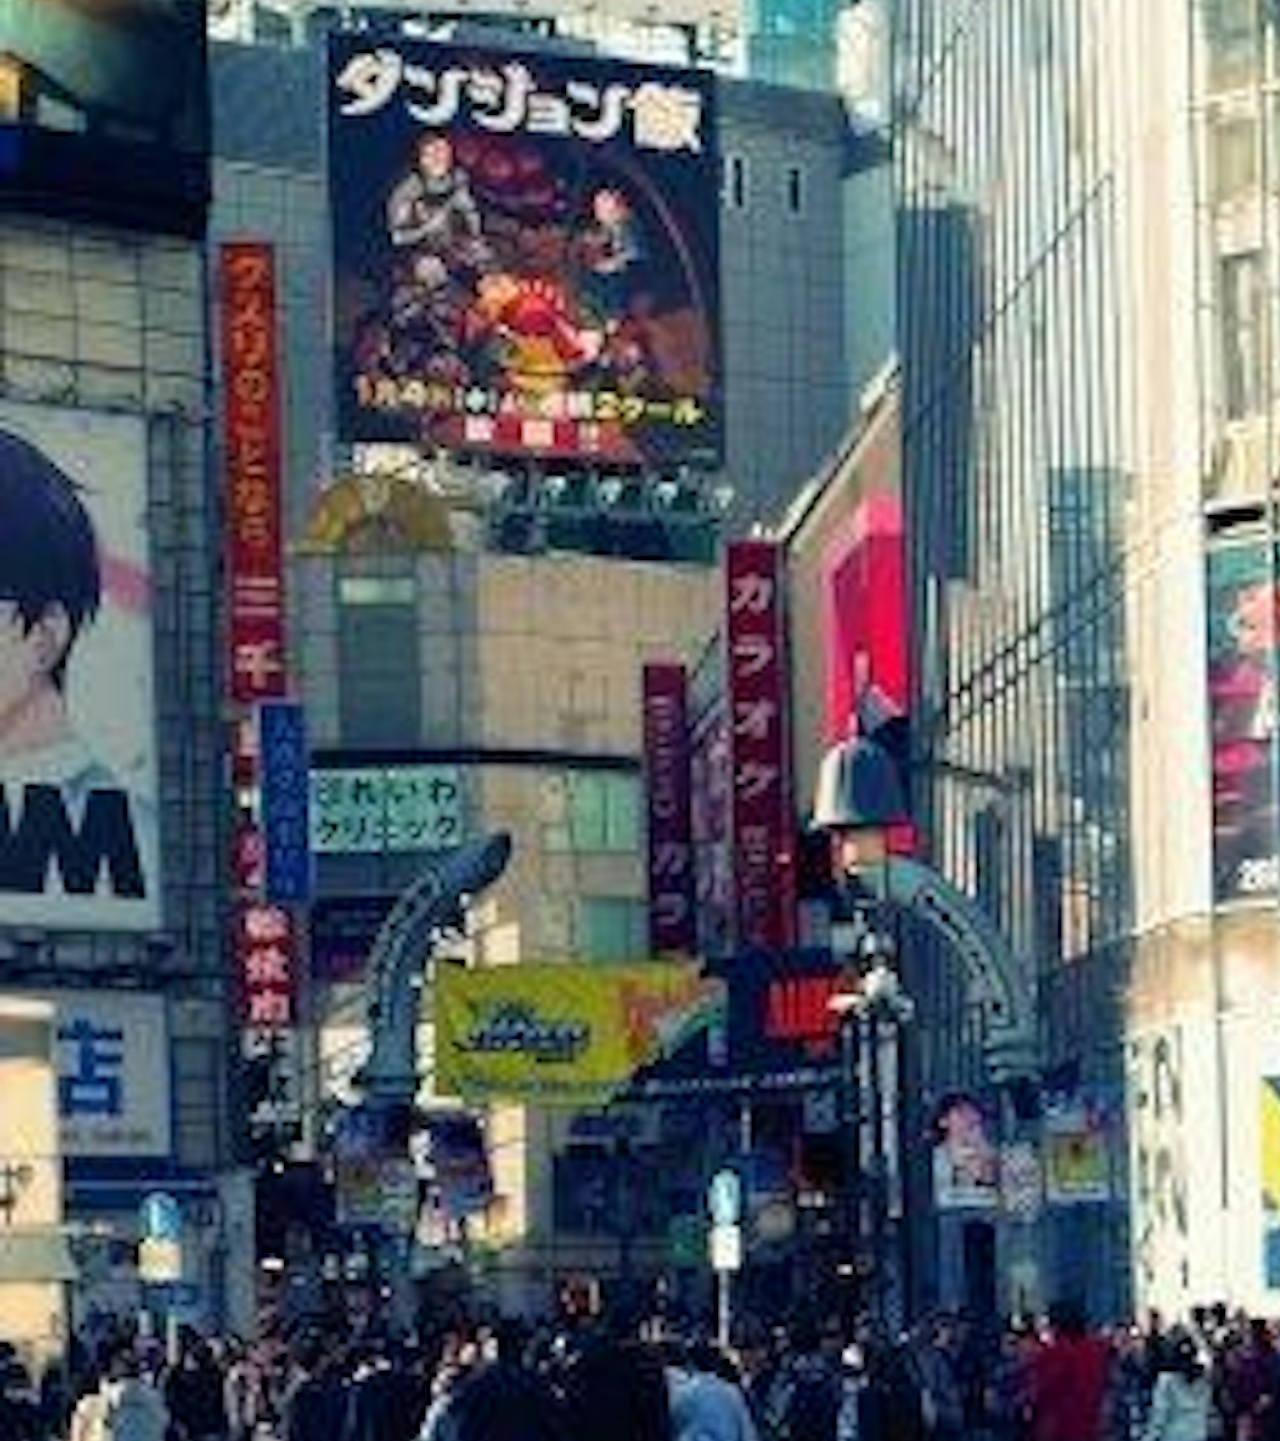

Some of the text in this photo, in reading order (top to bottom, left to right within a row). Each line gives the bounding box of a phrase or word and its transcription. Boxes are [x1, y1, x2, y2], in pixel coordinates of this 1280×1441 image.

[335, 47, 703, 155] ダンジョン飯
